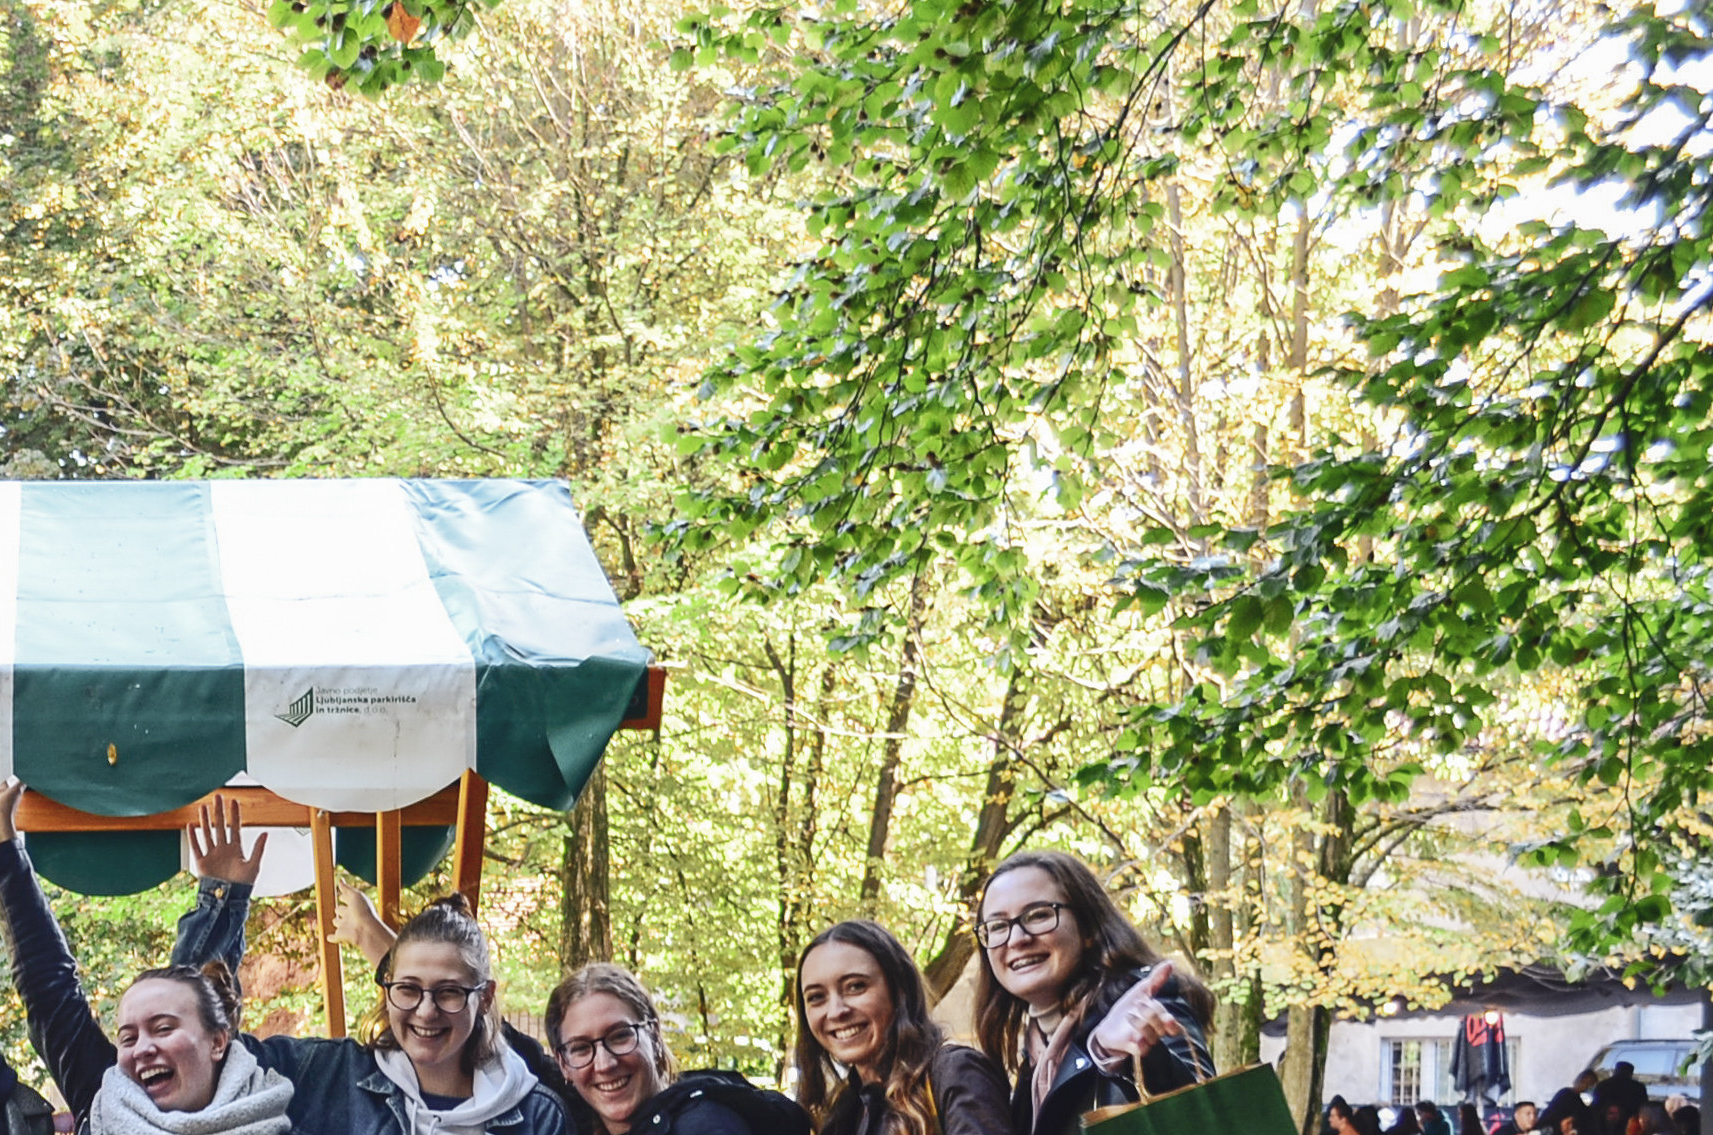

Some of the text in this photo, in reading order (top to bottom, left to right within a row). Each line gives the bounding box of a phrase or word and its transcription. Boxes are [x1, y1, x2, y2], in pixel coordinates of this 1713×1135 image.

[316, 695, 417, 705] Ljubljanska parkirišča
[315, 706, 325, 714] in
